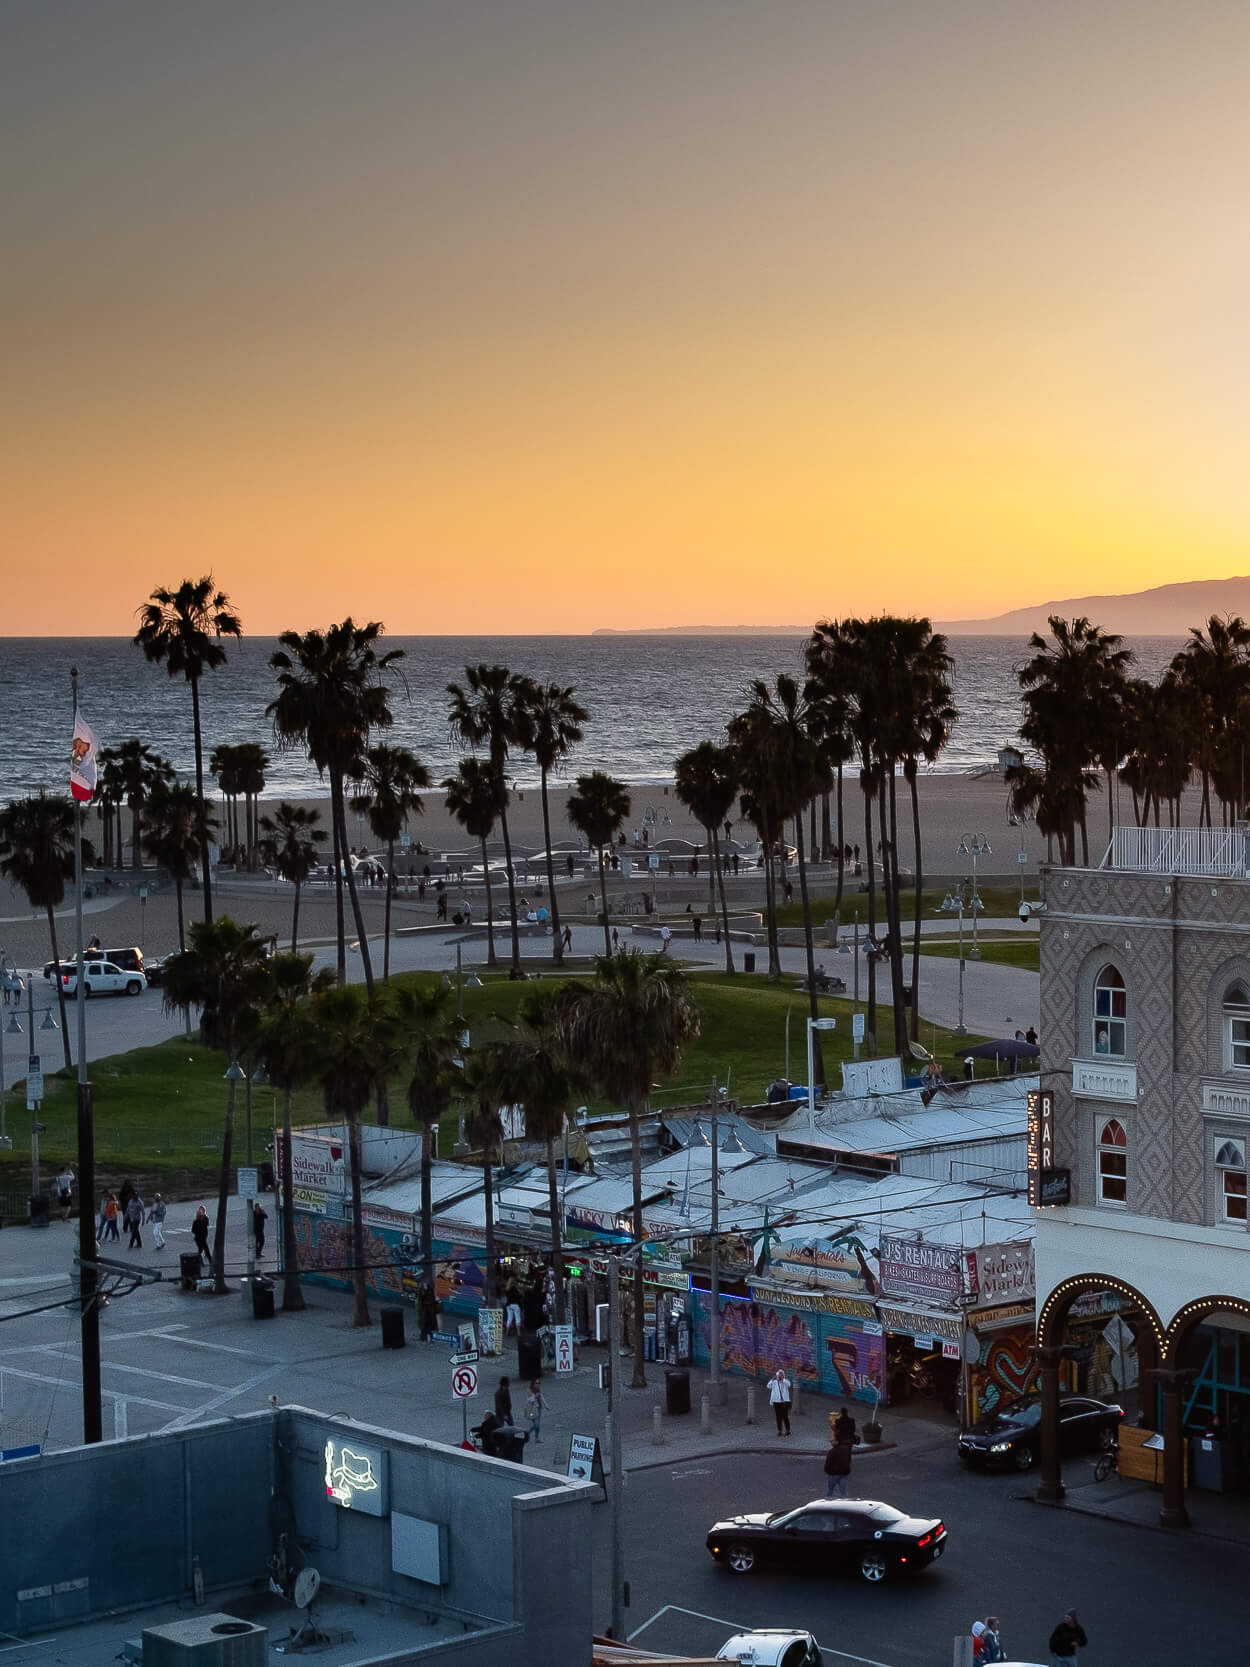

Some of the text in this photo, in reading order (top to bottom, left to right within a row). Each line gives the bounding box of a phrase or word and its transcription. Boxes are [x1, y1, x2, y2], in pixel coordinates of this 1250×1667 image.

[1043, 1098, 1051, 1167] BAR
[294, 1157, 334, 1173] Sidewalk
[294, 1170, 328, 1186] Market
[905, 1246, 957, 1270] RENTALS
[560, 1339, 570, 1369] ATM
[944, 1345, 958, 1355] ATM
[574, 1439, 593, 1450] PUBLIC
